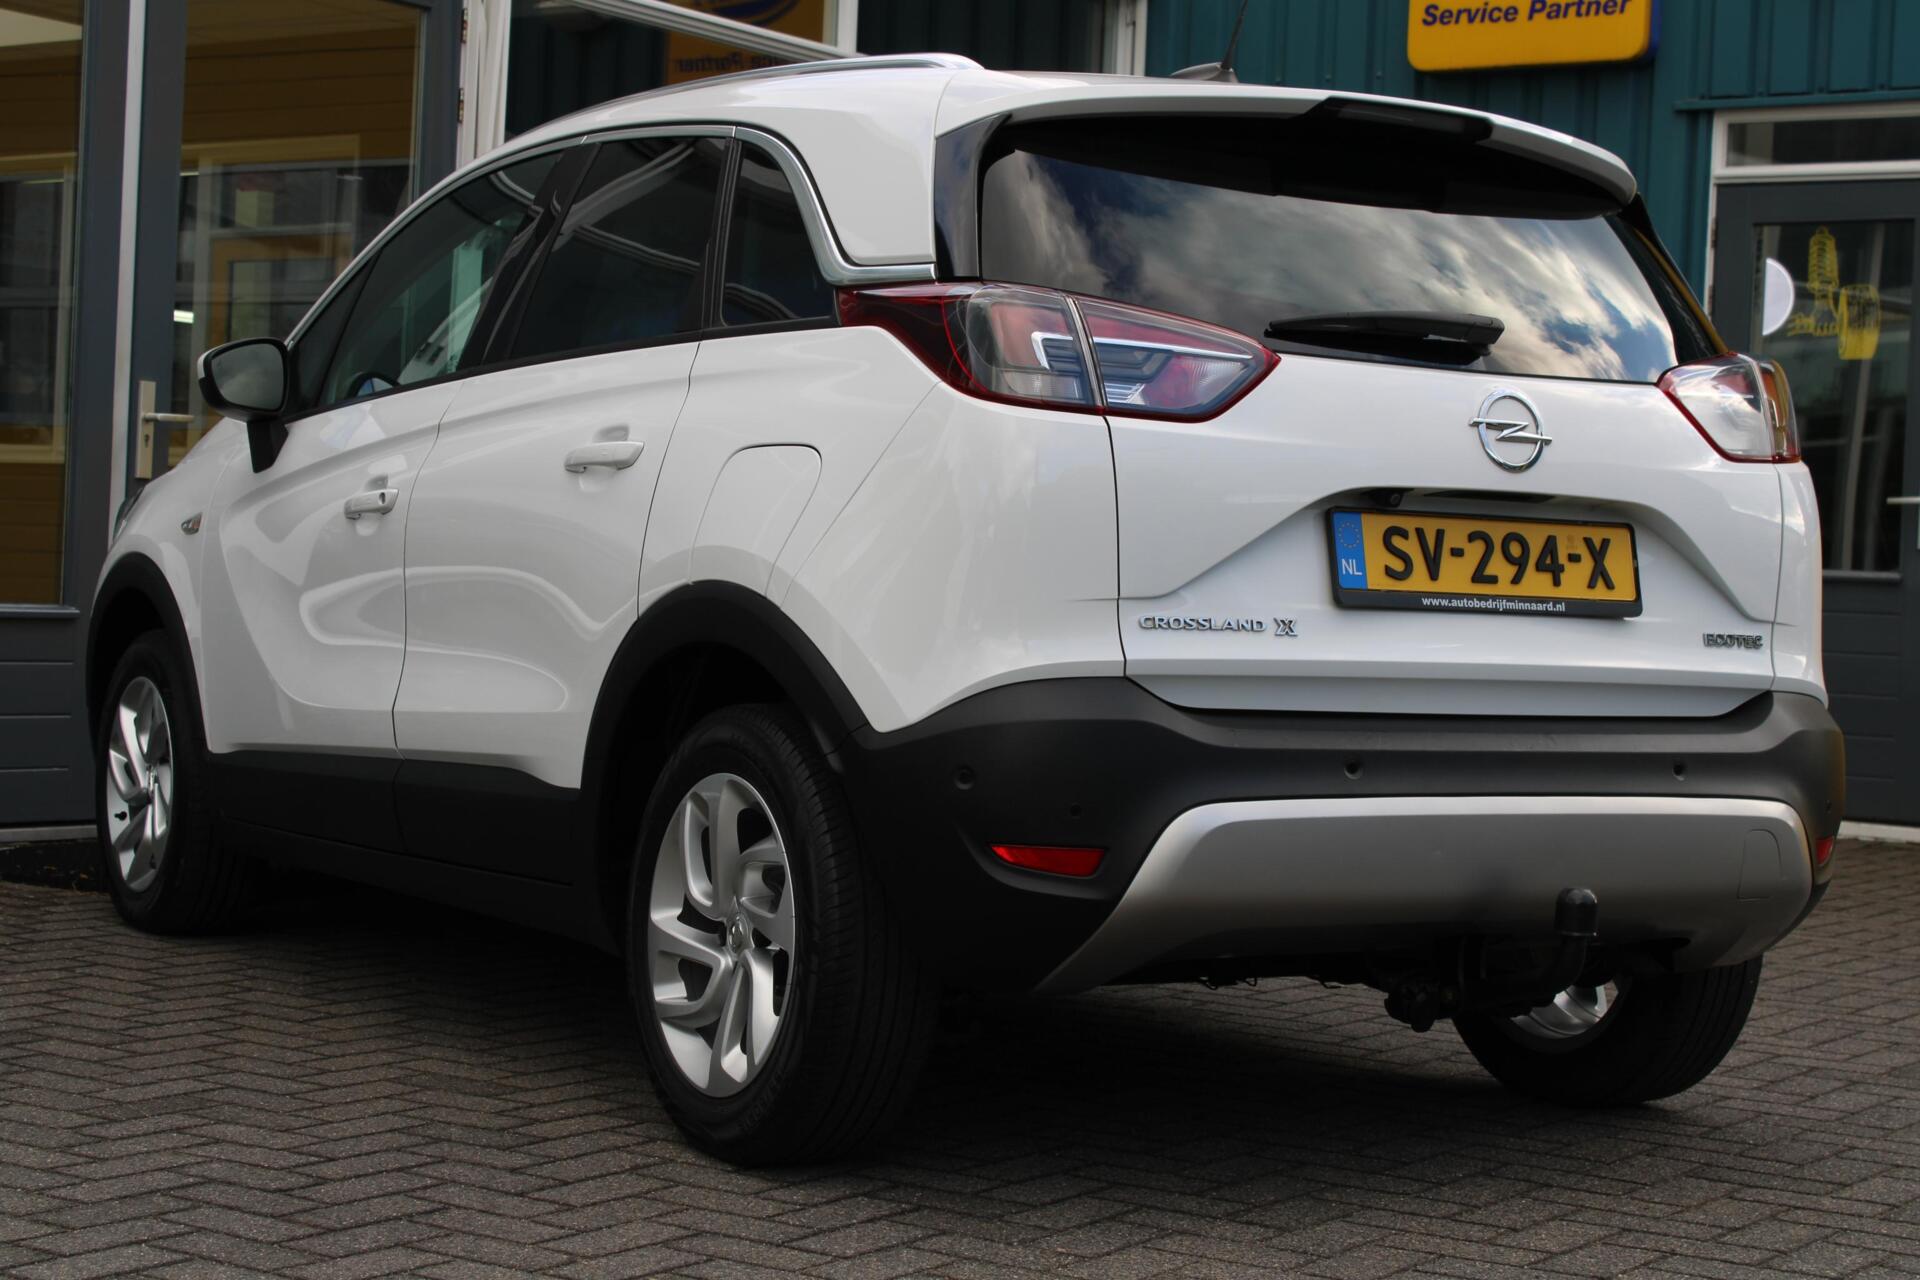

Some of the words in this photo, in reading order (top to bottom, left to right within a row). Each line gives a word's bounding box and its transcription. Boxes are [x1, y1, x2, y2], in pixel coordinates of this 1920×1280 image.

[1422, 2, 1518, 26] Service
[1527, 0, 1631, 21] Partner
[1341, 558, 1363, 576] NL
[1382, 525, 1615, 590] SV-294-X
[1421, 596, 1566, 612] www.autobedrijfminnaard.nl
[1138, 615, 1267, 632] CROSSLAND
[1273, 617, 1298, 637] X
[1702, 633, 1763, 649] ECOTEC
